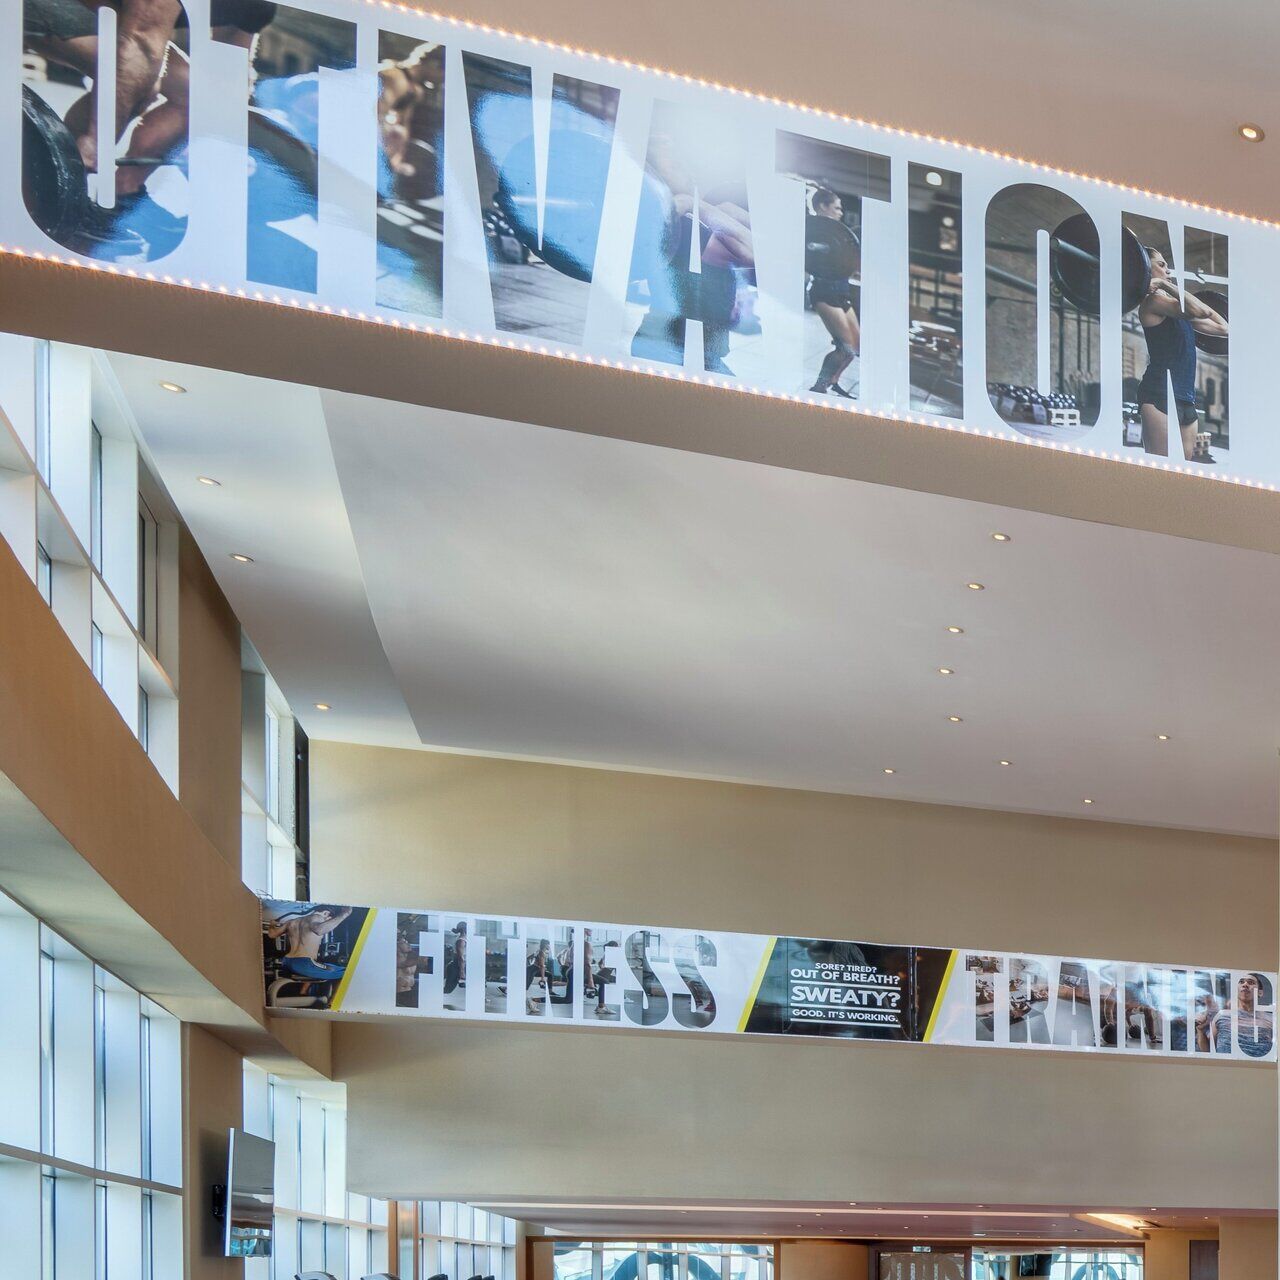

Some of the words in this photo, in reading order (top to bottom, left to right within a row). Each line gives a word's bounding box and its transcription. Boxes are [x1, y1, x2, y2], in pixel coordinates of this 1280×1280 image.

[395, 912, 718, 1029] FITNESS
[790, 968, 817, 979] OUT
[821, 971, 840, 981] OF
[842, 972, 900, 985] BREATH?
[815, 962, 845, 971] SORE?
[847, 964, 877, 973] TIRED?
[791, 985, 901, 1007] SWEATY?
[792, 1008, 826, 1018] GOOD.
[828, 1010, 845, 1019] IT'S
[847, 1012, 898, 1022] WORKING.
[965, 954, 1274, 1058] TRAINING
